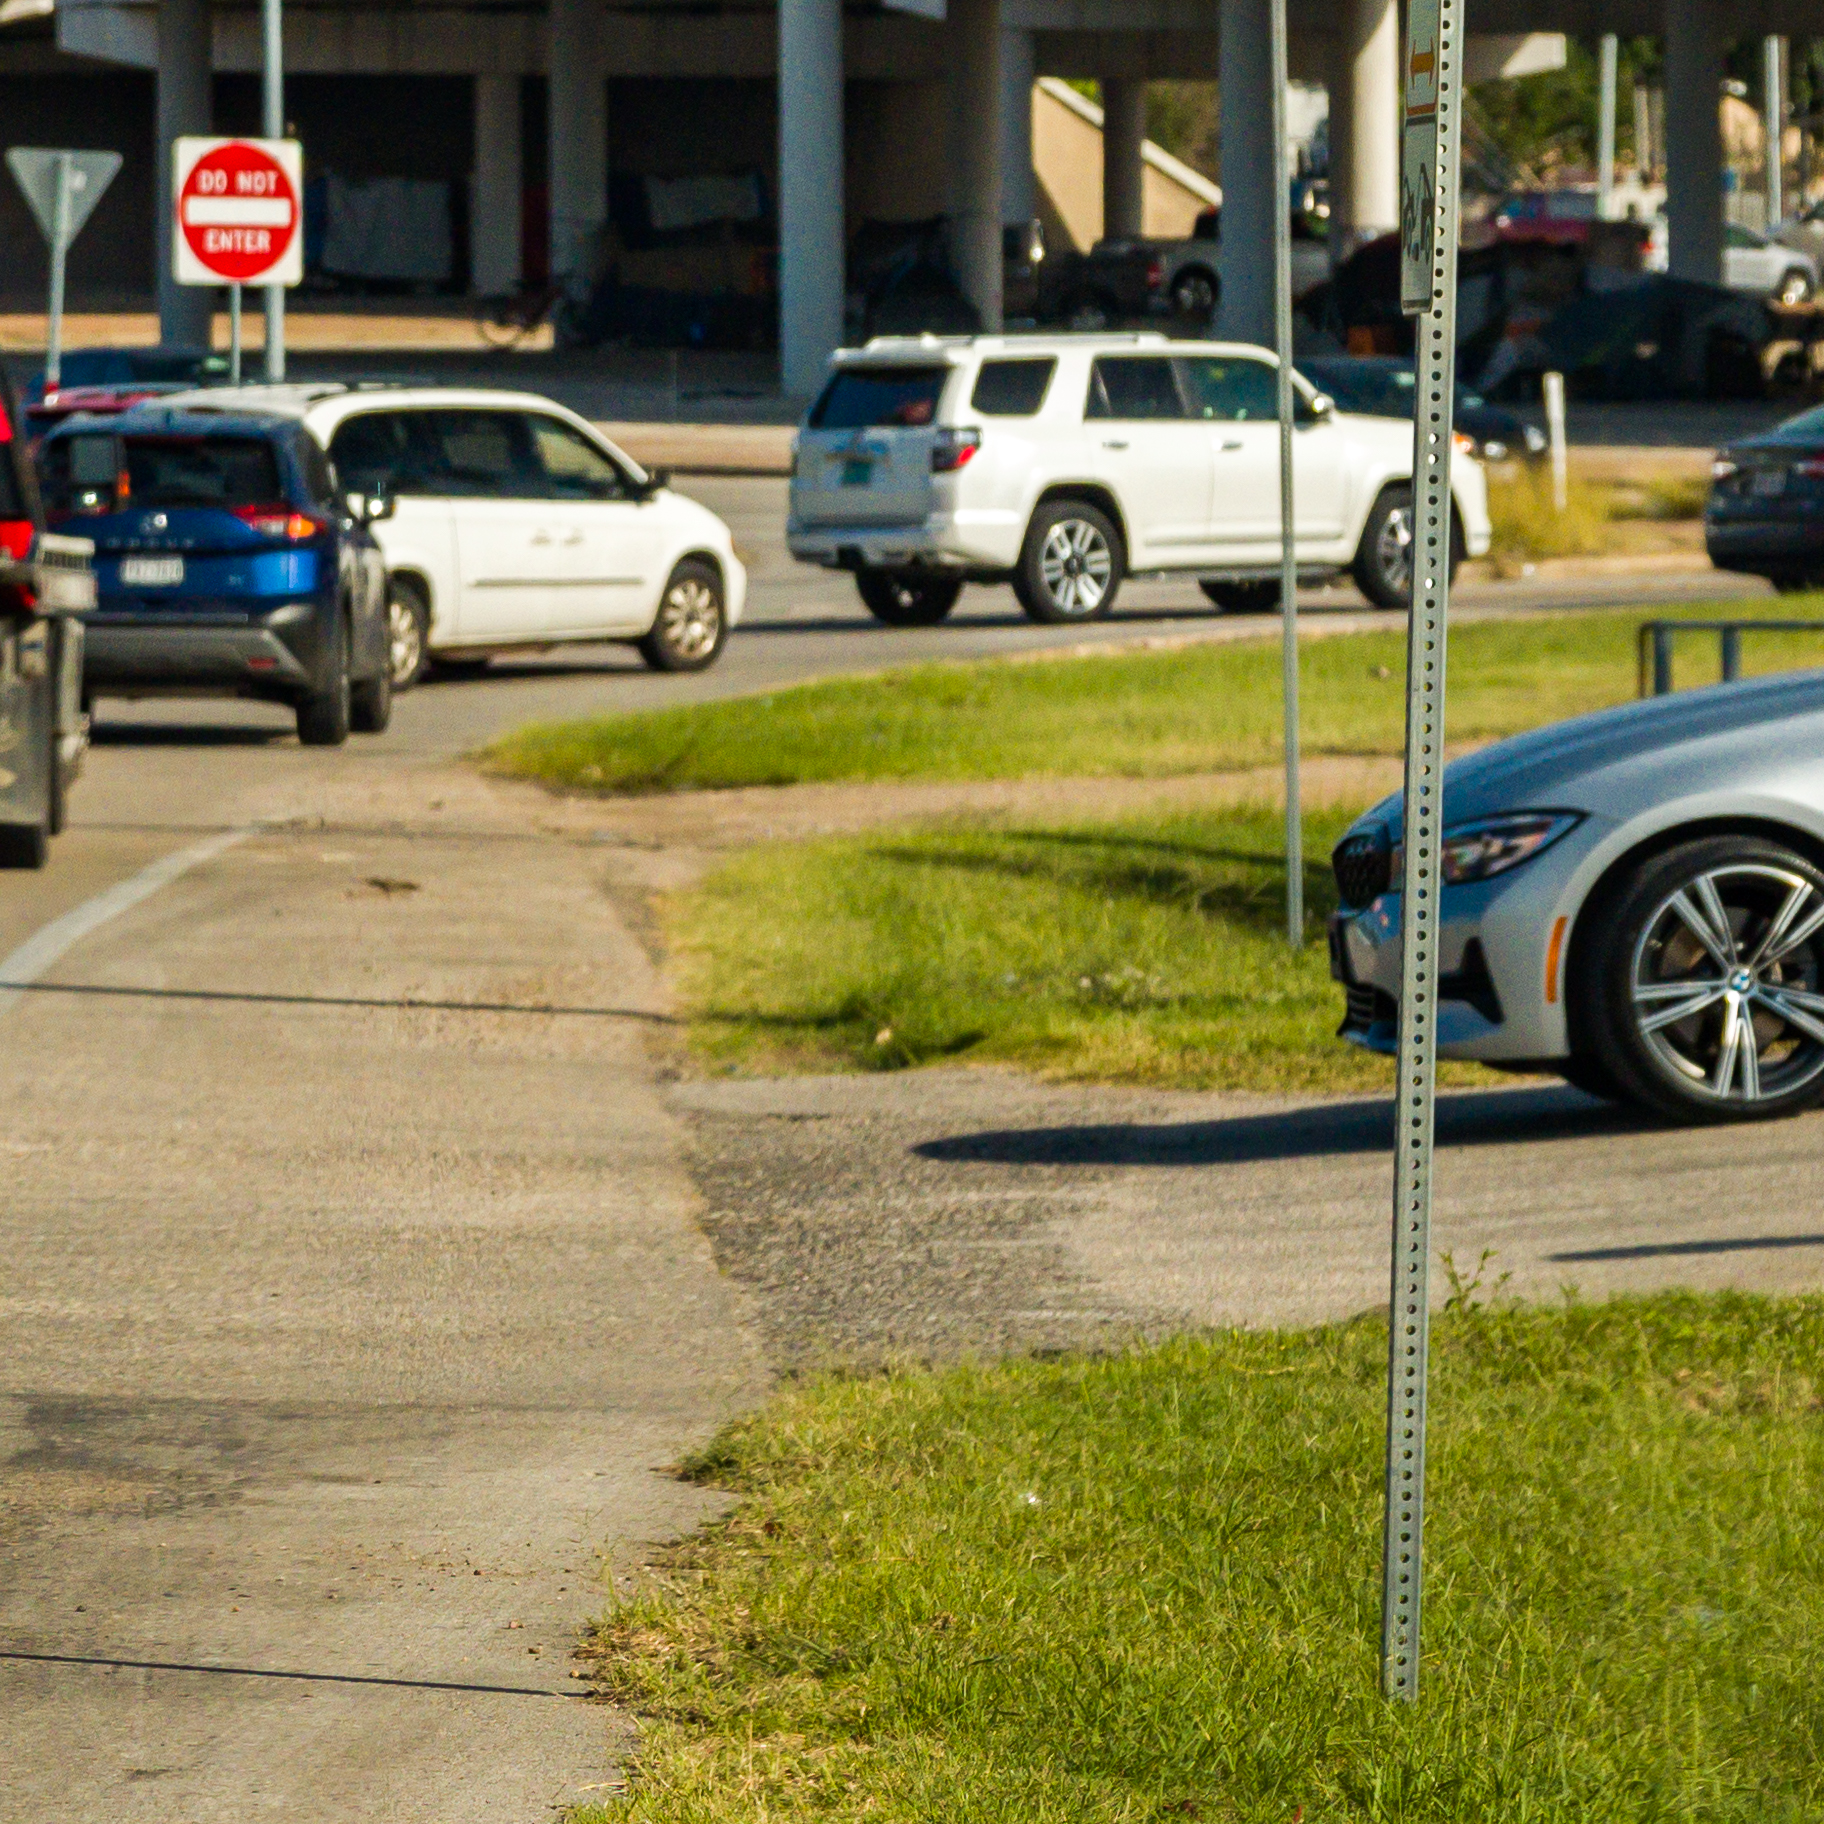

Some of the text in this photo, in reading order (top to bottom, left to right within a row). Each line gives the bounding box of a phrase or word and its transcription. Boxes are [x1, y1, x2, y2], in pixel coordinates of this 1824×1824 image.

[196, 168, 280, 195] DO NOT
[201, 228, 273, 255] ENTER
